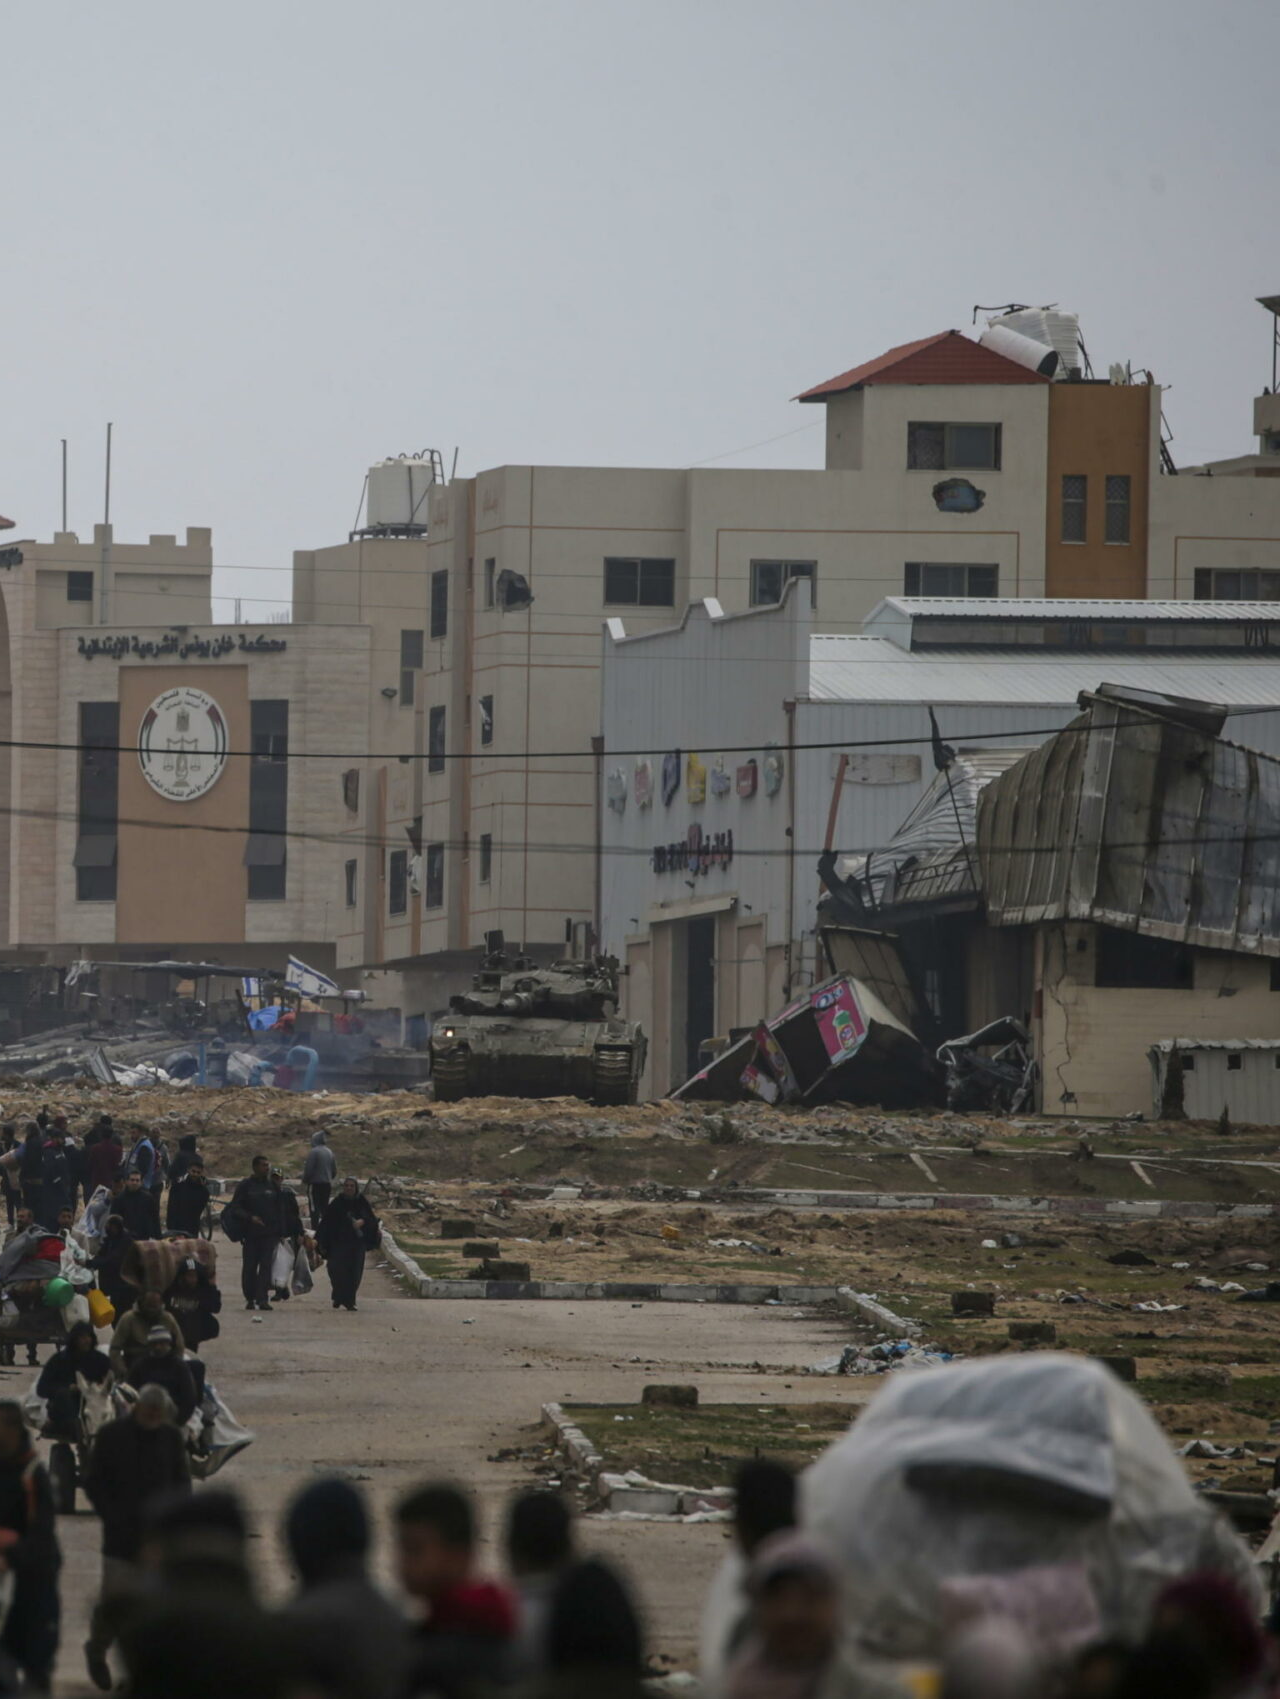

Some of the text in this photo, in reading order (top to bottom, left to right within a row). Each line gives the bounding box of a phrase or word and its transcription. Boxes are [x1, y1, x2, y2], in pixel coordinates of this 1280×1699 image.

[131, 634, 178, 659] الشرعية
[180, 634, 210, 659] يونس
[212, 633, 236, 658] خان
[238, 633, 287, 653] محكمة
